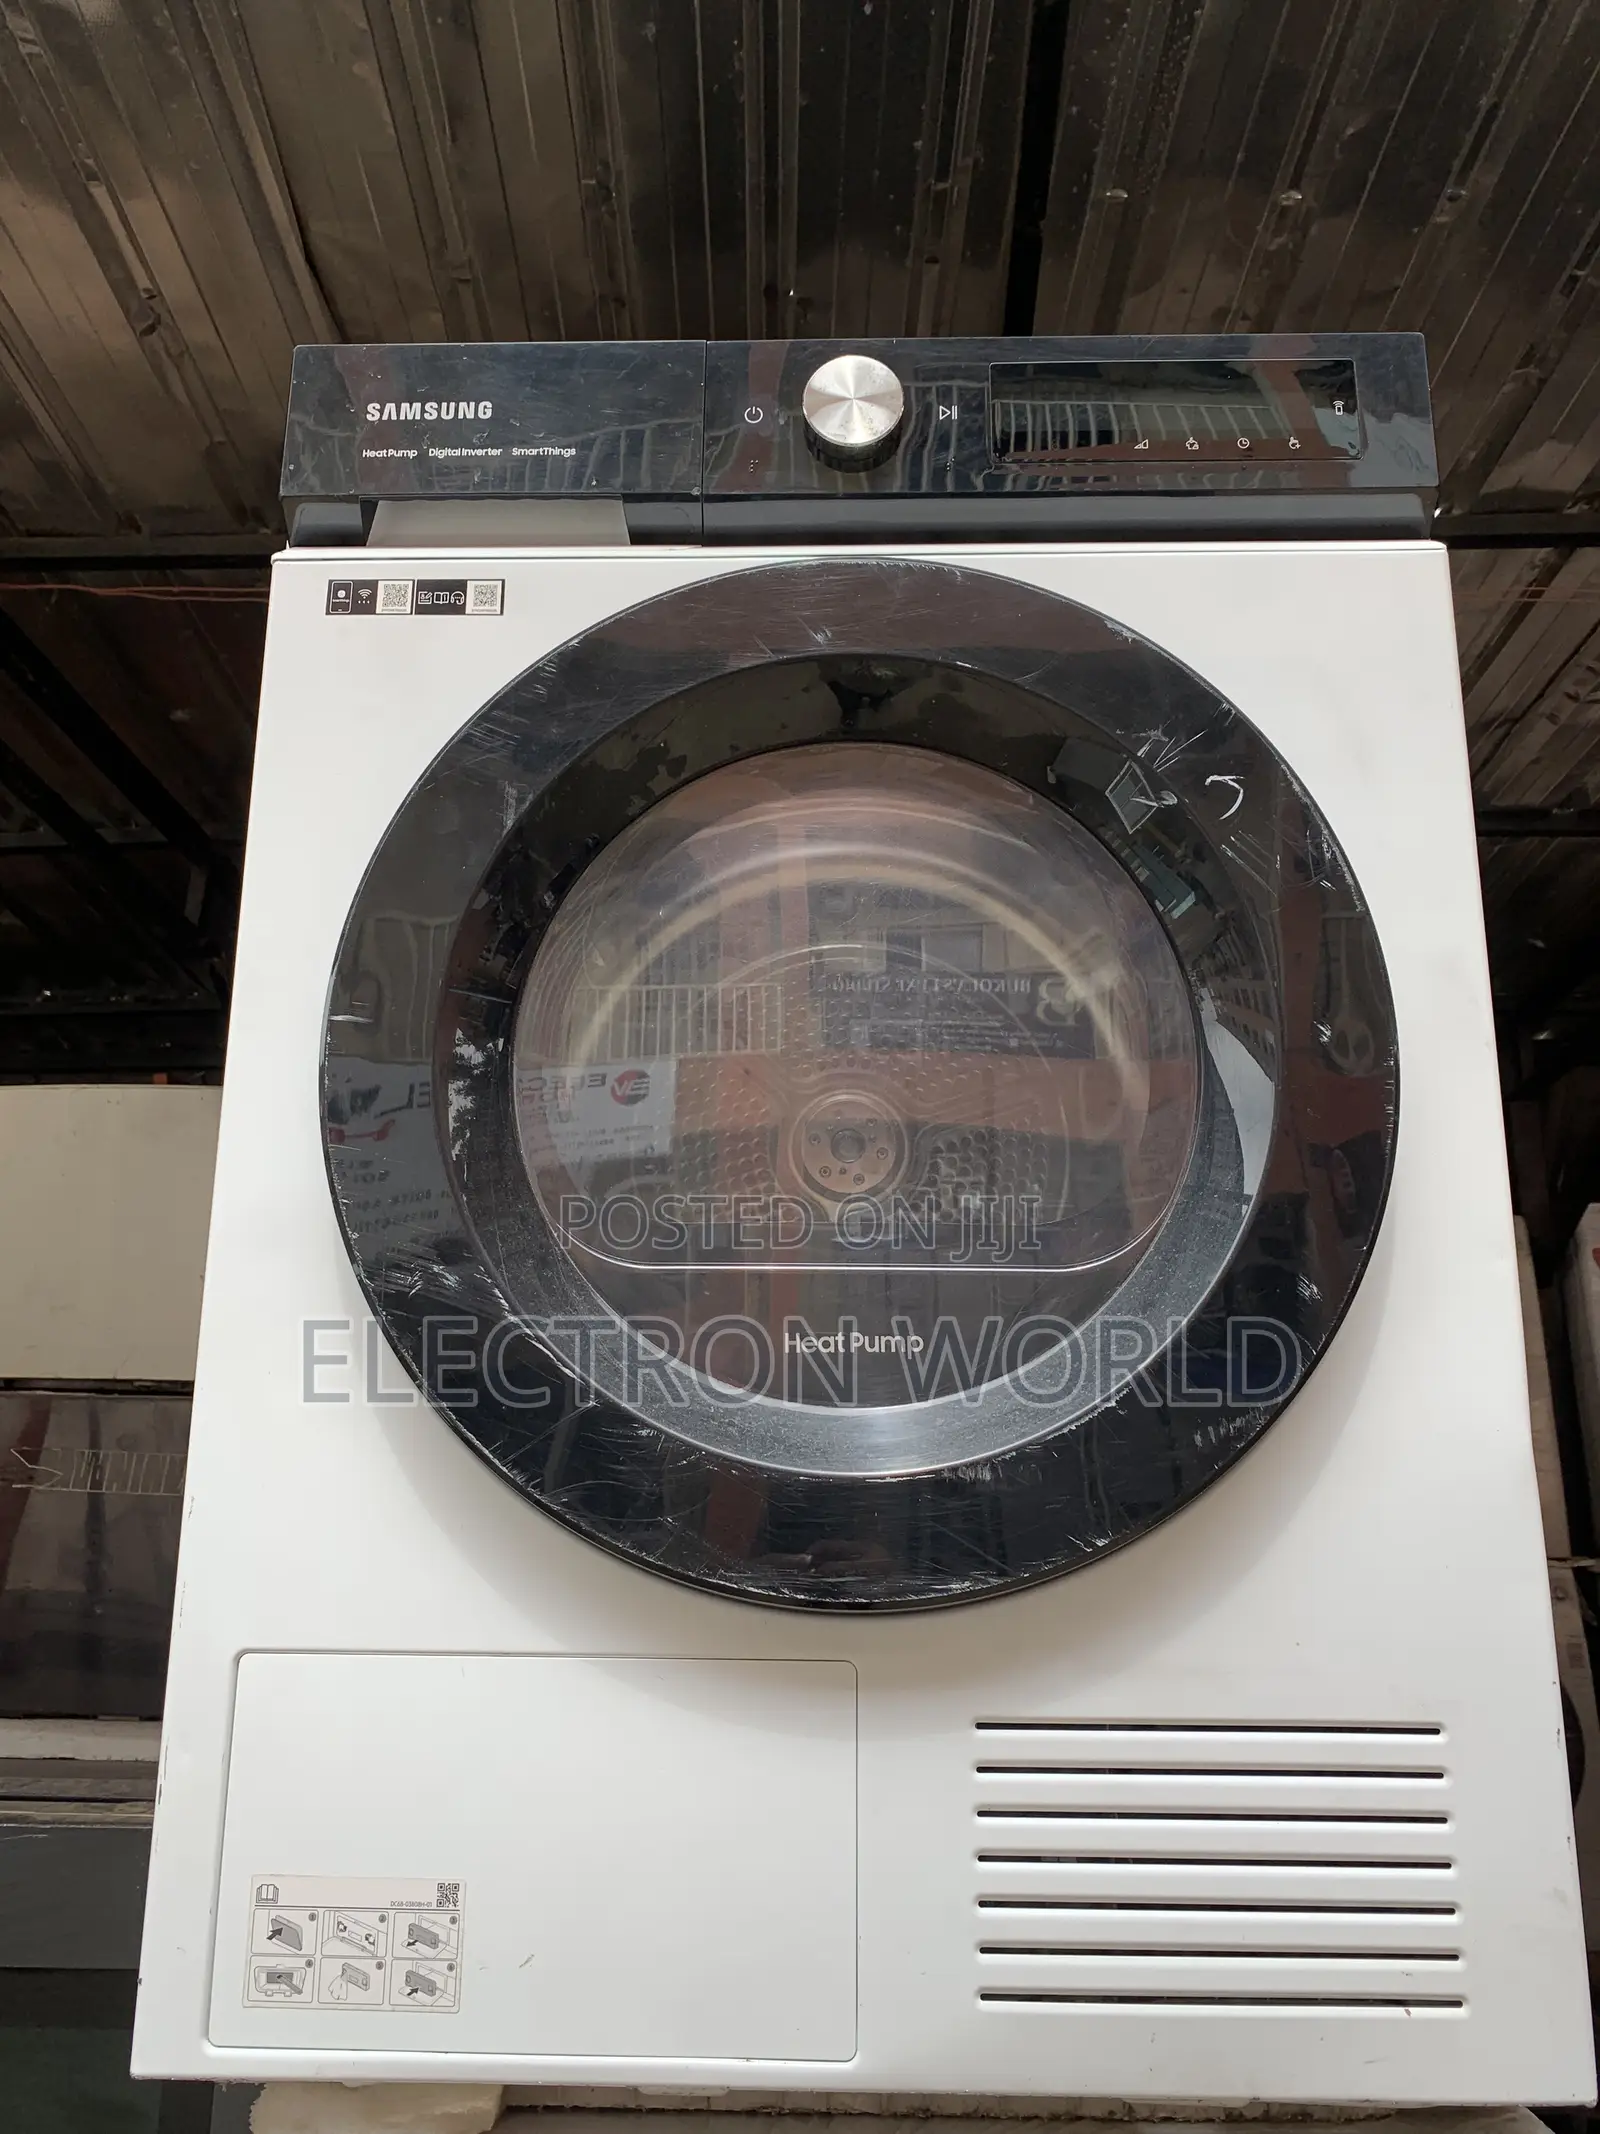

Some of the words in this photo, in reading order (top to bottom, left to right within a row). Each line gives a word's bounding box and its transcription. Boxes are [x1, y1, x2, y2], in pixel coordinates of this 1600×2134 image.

[366, 401, 493, 421] SAMSUNG
[362, 449, 387, 458] Heat
[388, 449, 418, 459] Pump
[428, 448, 460, 459] Digital
[462, 447, 502, 457] Inverter
[511, 447, 577, 458] SmartThings
[783, 1332, 847, 1354] Heat
[849, 1332, 925, 1360] Pump
